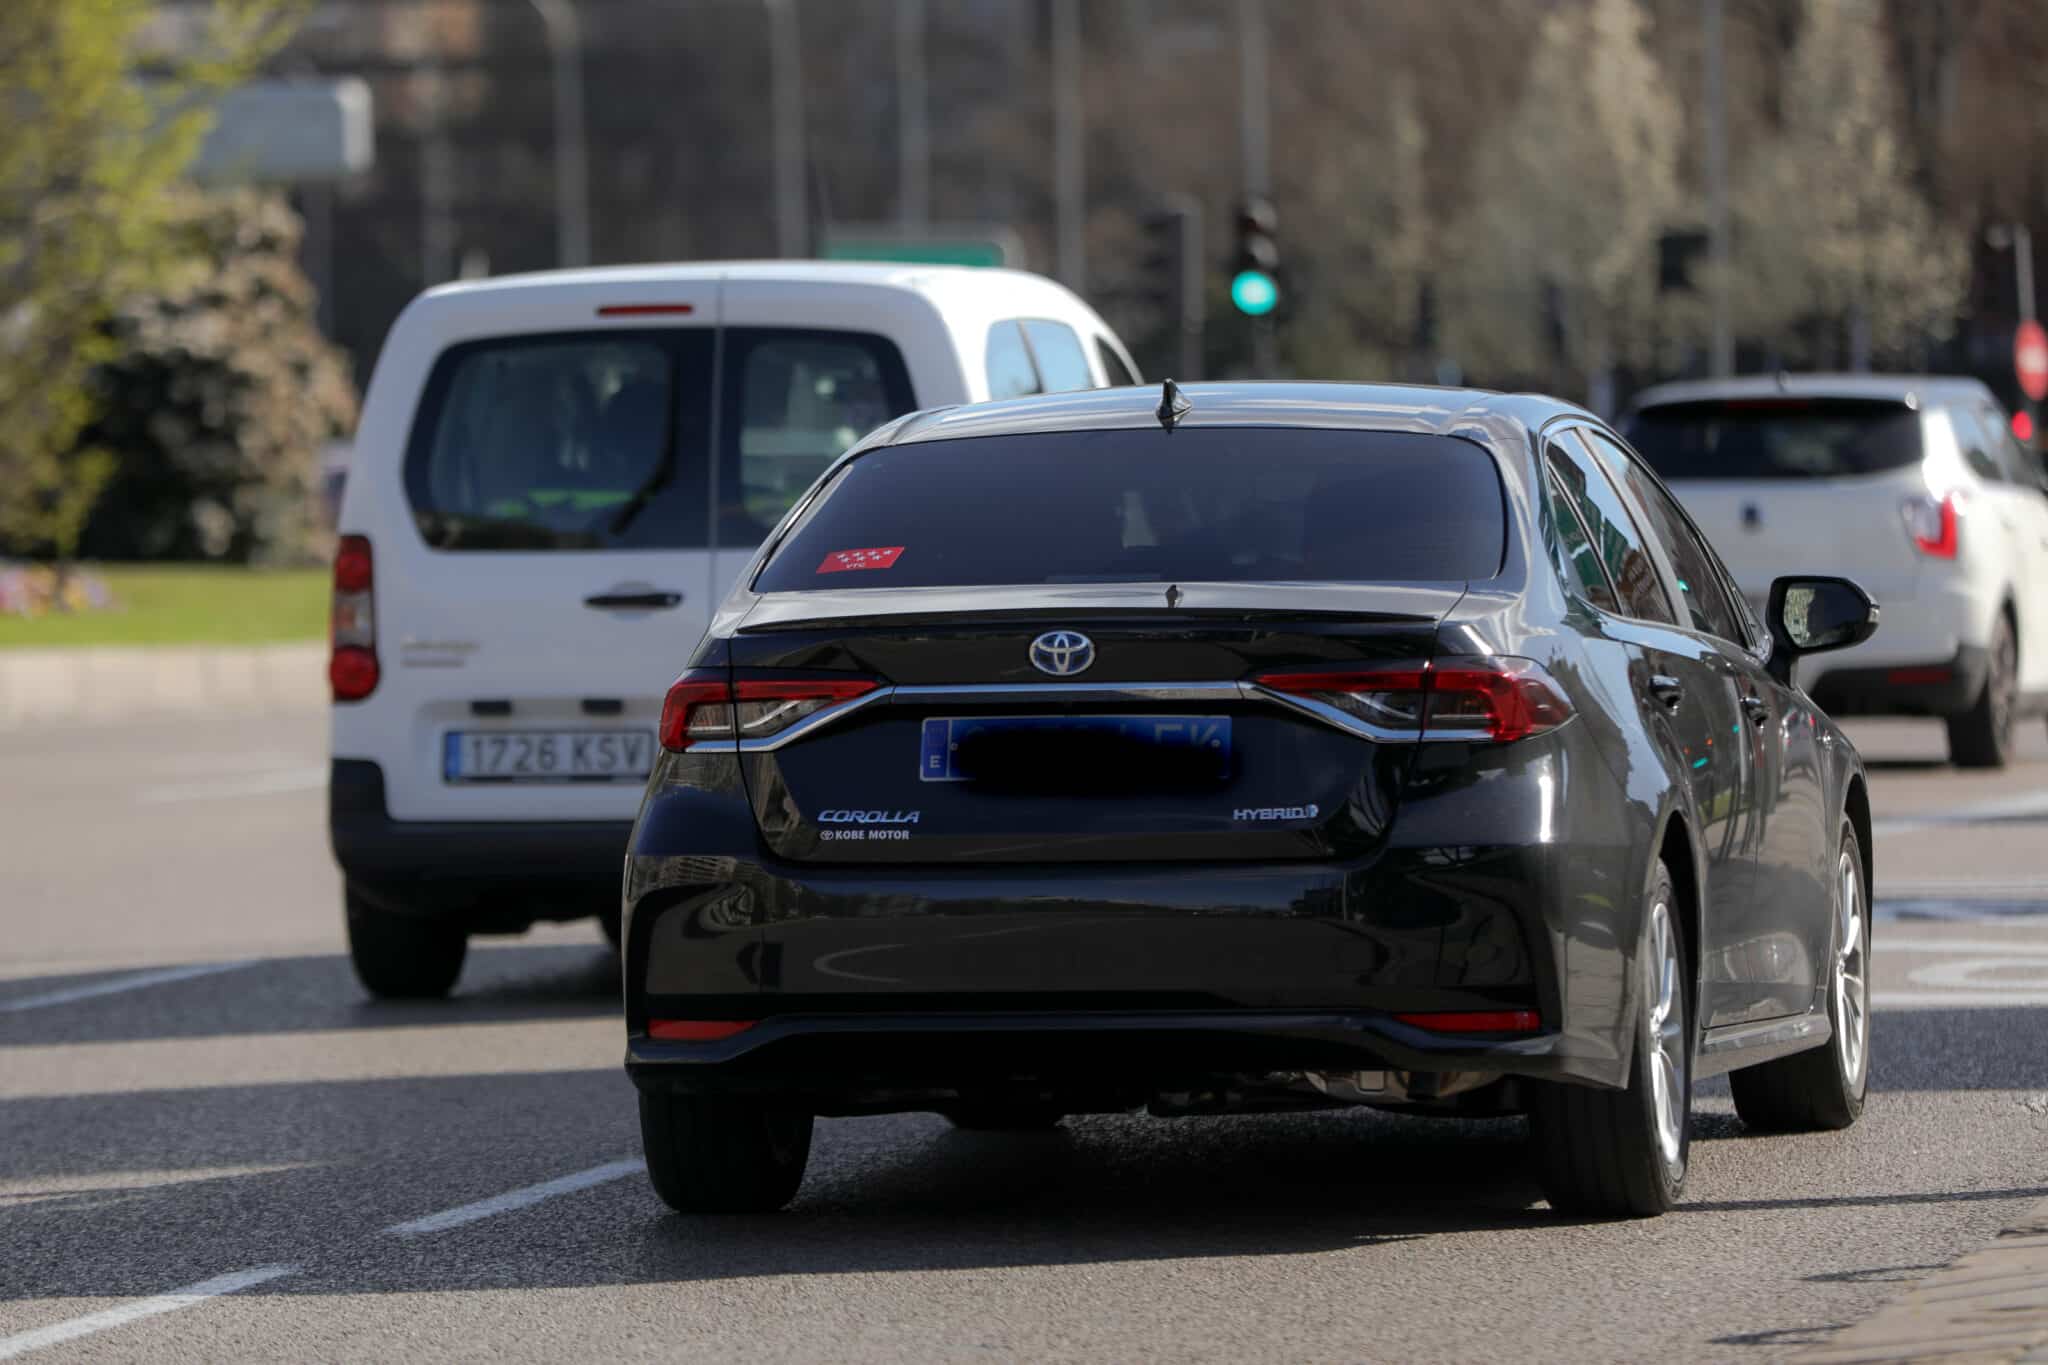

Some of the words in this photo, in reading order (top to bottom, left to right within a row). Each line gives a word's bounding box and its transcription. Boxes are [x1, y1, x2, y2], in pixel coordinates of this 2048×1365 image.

[472, 738, 557, 773] 1726
[571, 738, 643, 773] KSV
[817, 810, 921, 824] COROLLA
[1233, 807, 1306, 821] HYBRID
[835, 830, 865, 841] KOBE
[868, 830, 910, 841] MOTOR
